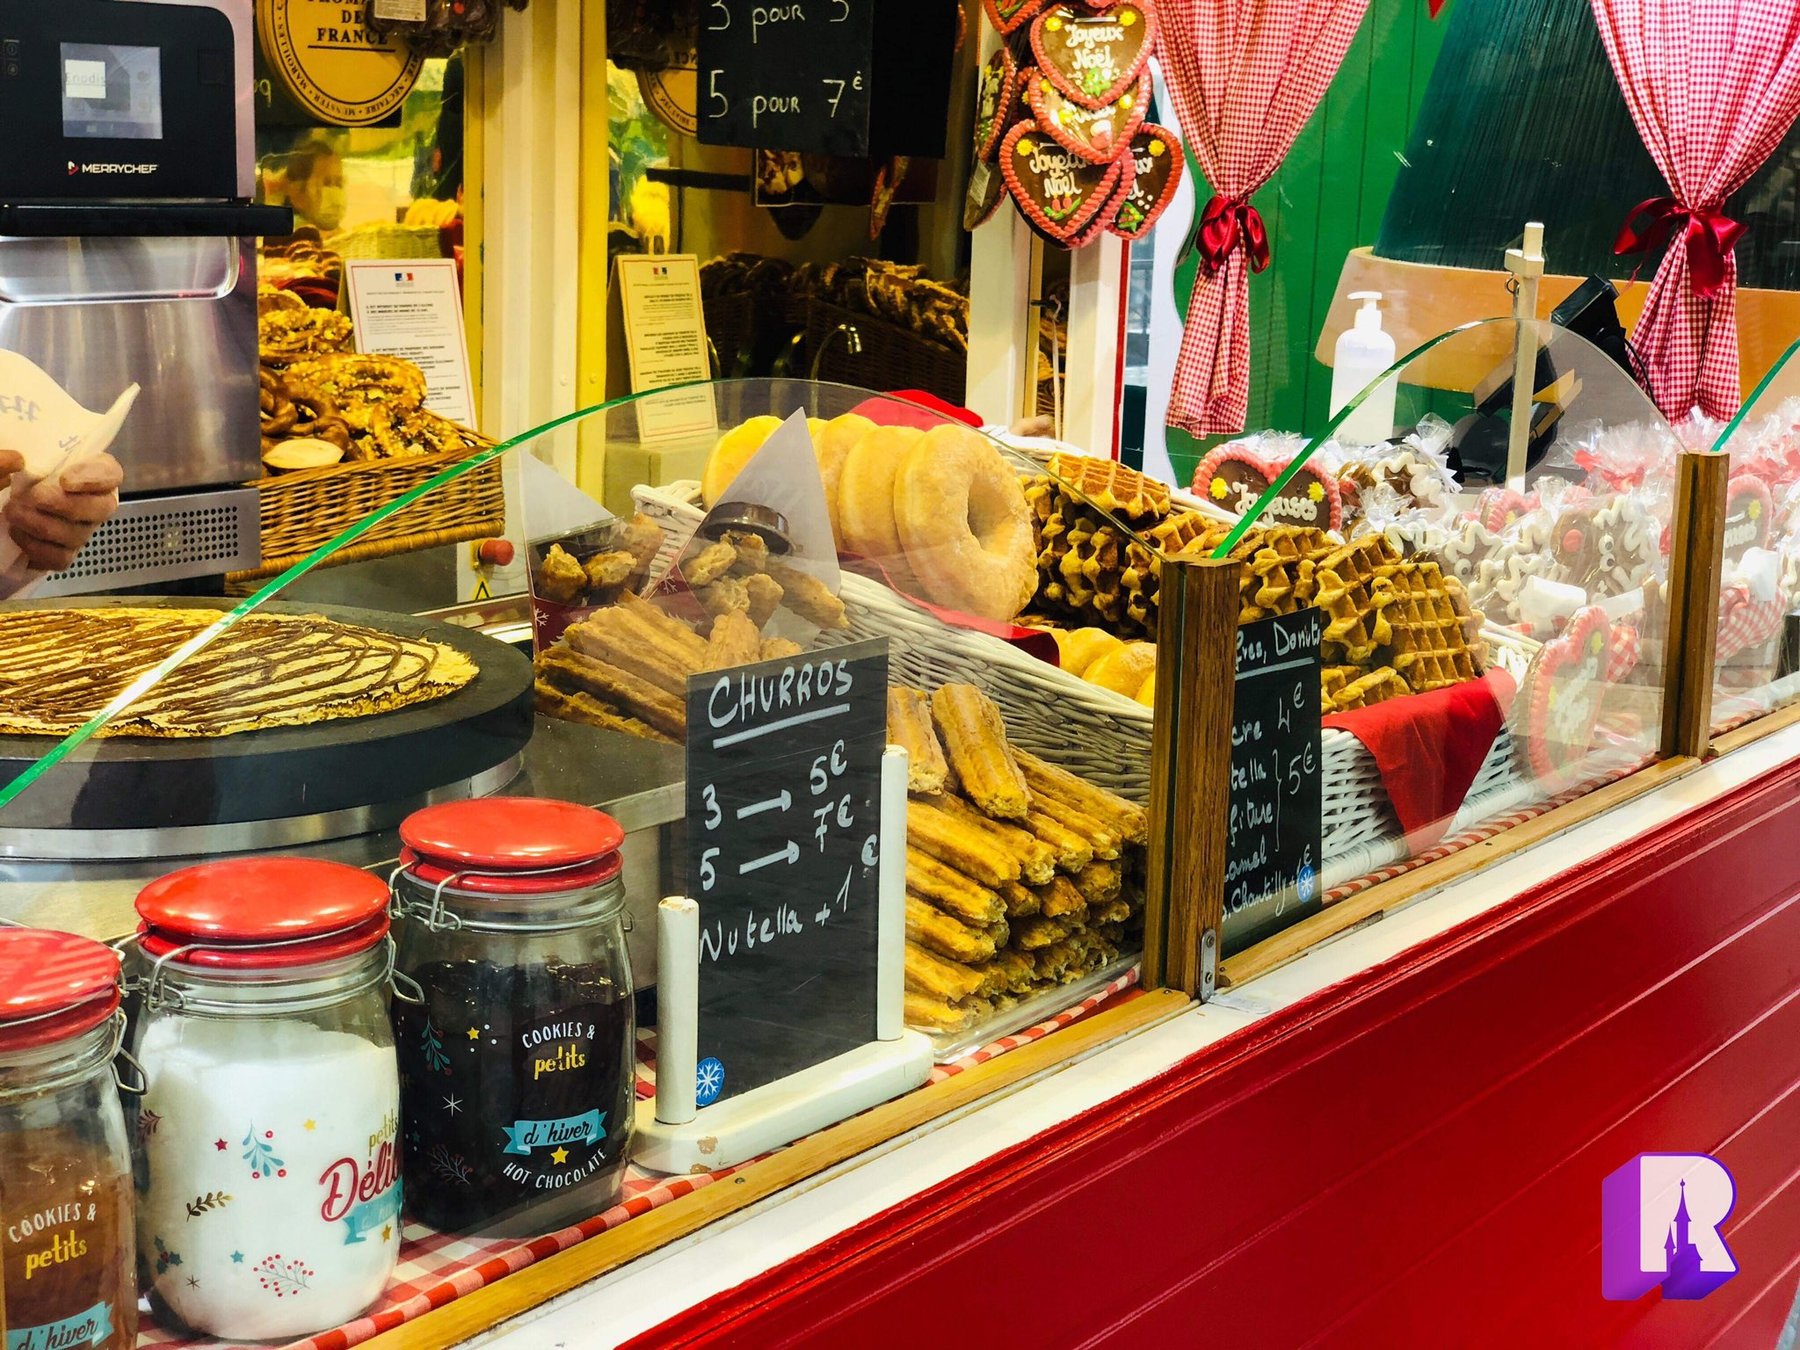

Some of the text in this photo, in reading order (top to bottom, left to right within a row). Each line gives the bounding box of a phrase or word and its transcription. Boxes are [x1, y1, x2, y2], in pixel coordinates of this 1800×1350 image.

[317, 28, 388, 45] FRANCE
[341, 10, 364, 24] DE
[1064, 24, 1124, 49] Joyeux
[709, 70, 728, 118] 5
[82, 164, 157, 174] MERRYCHEF
[708, 659, 853, 728] CHURROS
[1231, 757, 1267, 792] tella
[702, 783, 722, 830] 3
[700, 847, 720, 891] 5
[699, 902, 803, 964] Nutella
[522, 1022, 596, 1049] COOKIES &
[534, 1043, 586, 1081] petits
[503, 1147, 608, 1189] HOT CHOCOLATE
[8, 1202, 97, 1244] COOKIES &
[26, 1229, 88, 1280] petits
